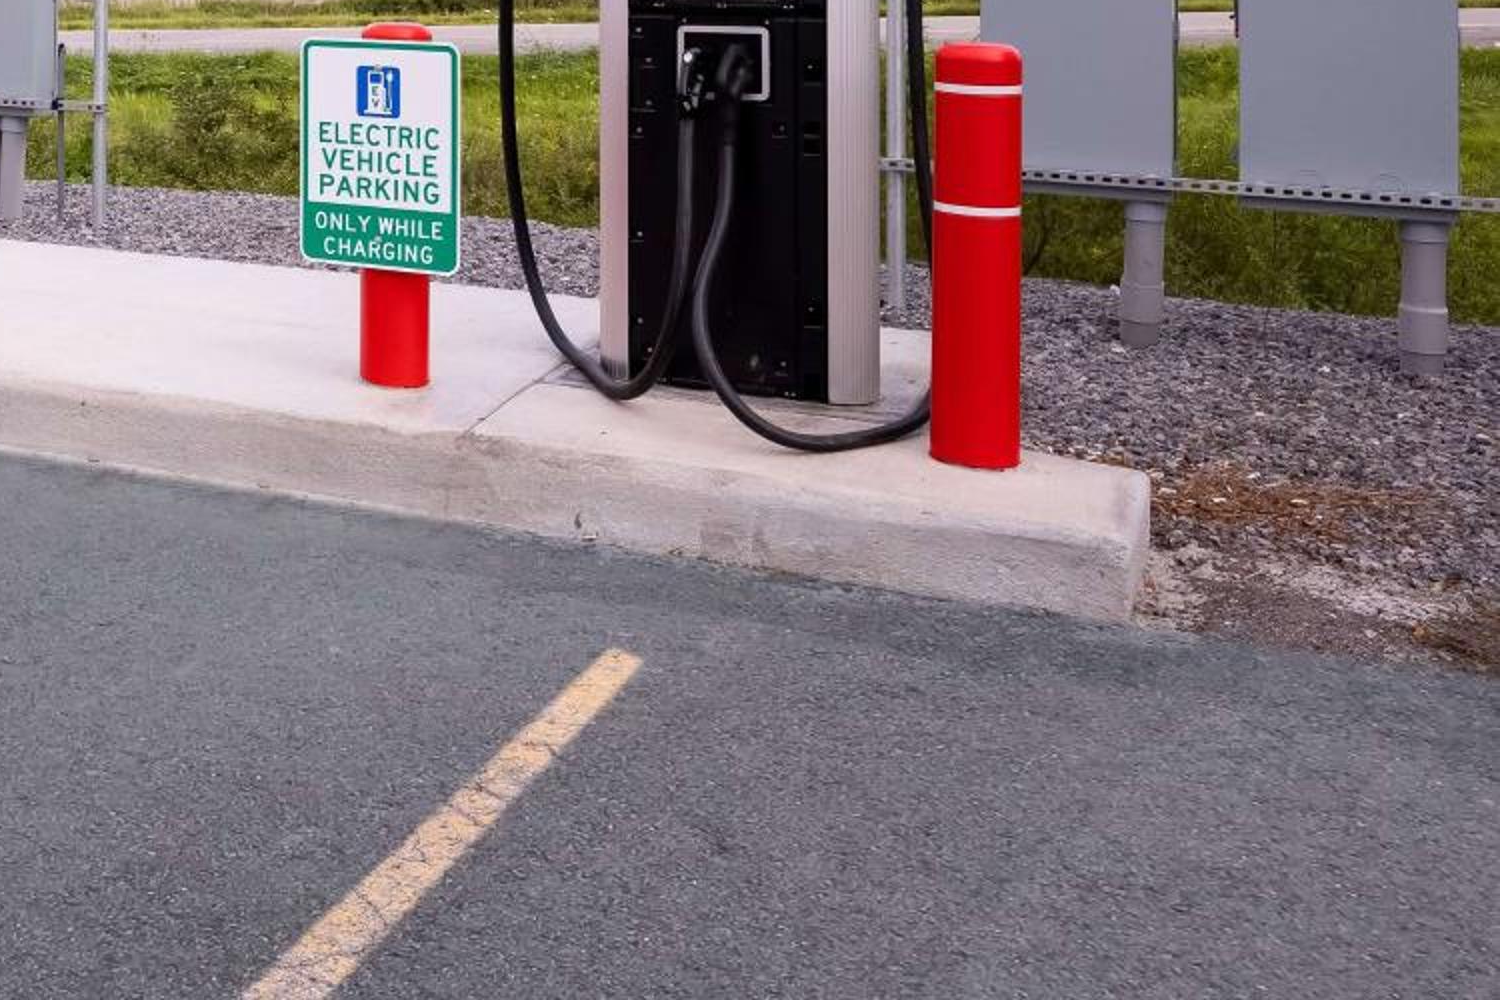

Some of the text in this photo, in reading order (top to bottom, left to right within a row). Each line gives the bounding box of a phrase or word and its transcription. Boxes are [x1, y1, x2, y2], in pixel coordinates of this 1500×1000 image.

[319, 121, 440, 150] ELECTRIC
[321, 148, 438, 178] VEHICLE
[319, 174, 440, 205] PARKING
[315, 211, 444, 241] ONLY WHILE
[323, 236, 434, 264] CHARGING
